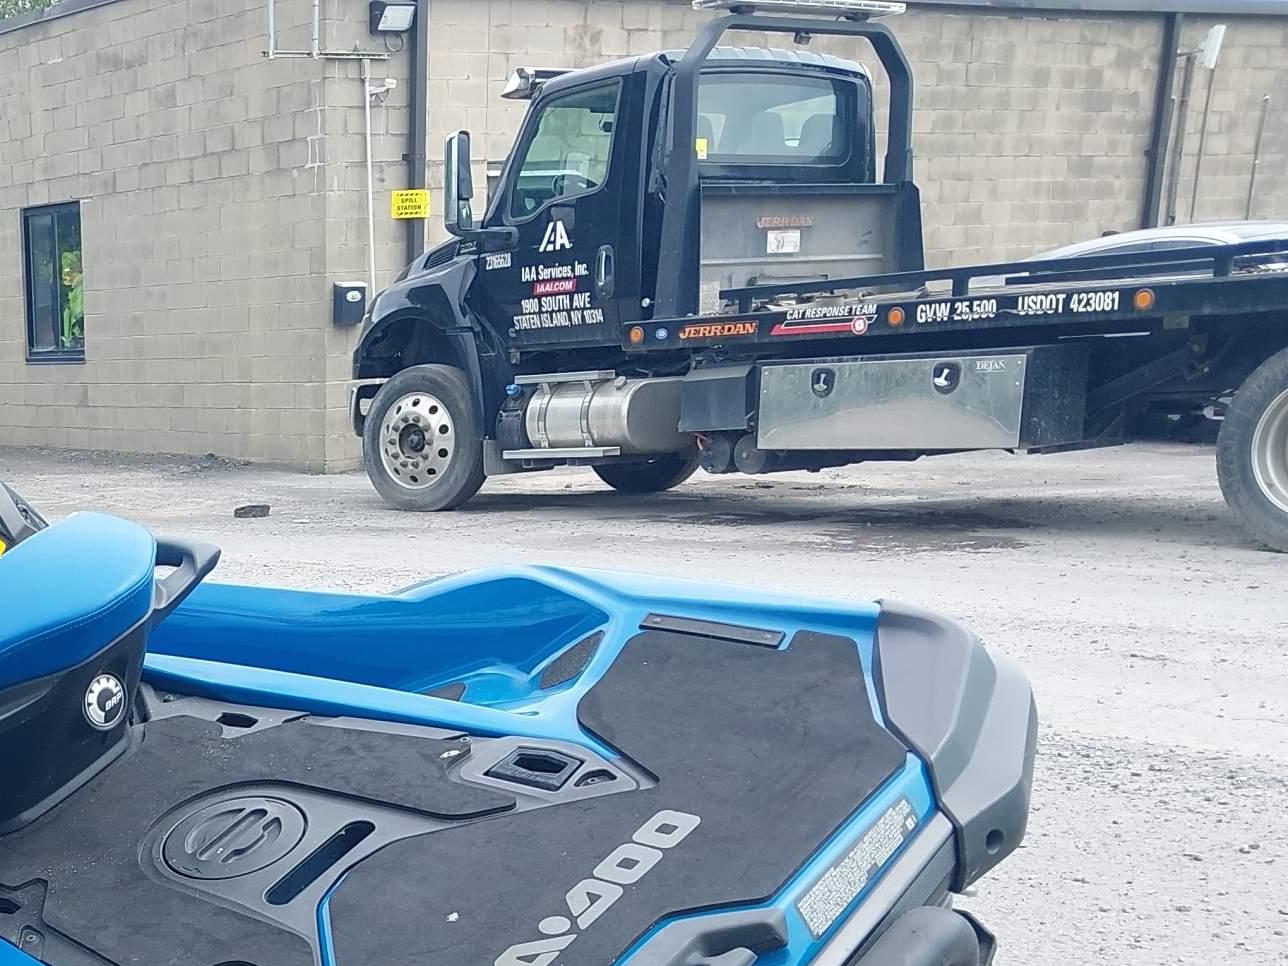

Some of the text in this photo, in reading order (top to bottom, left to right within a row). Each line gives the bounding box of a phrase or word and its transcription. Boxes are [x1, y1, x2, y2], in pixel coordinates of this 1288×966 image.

[521, 260, 589, 282] IAA Services, Inc.
[521, 292, 591, 314] 1900 SOUTH AVE
[786, 303, 877, 320] CAT RESPONSE TEAM
[916, 298, 998, 323] GVW 25,500
[1018, 291, 1120, 316] USDOT 423081
[514, 308, 604, 330] STATEN ISLAND, NY 10314
[105, 692, 123, 712] BRP
